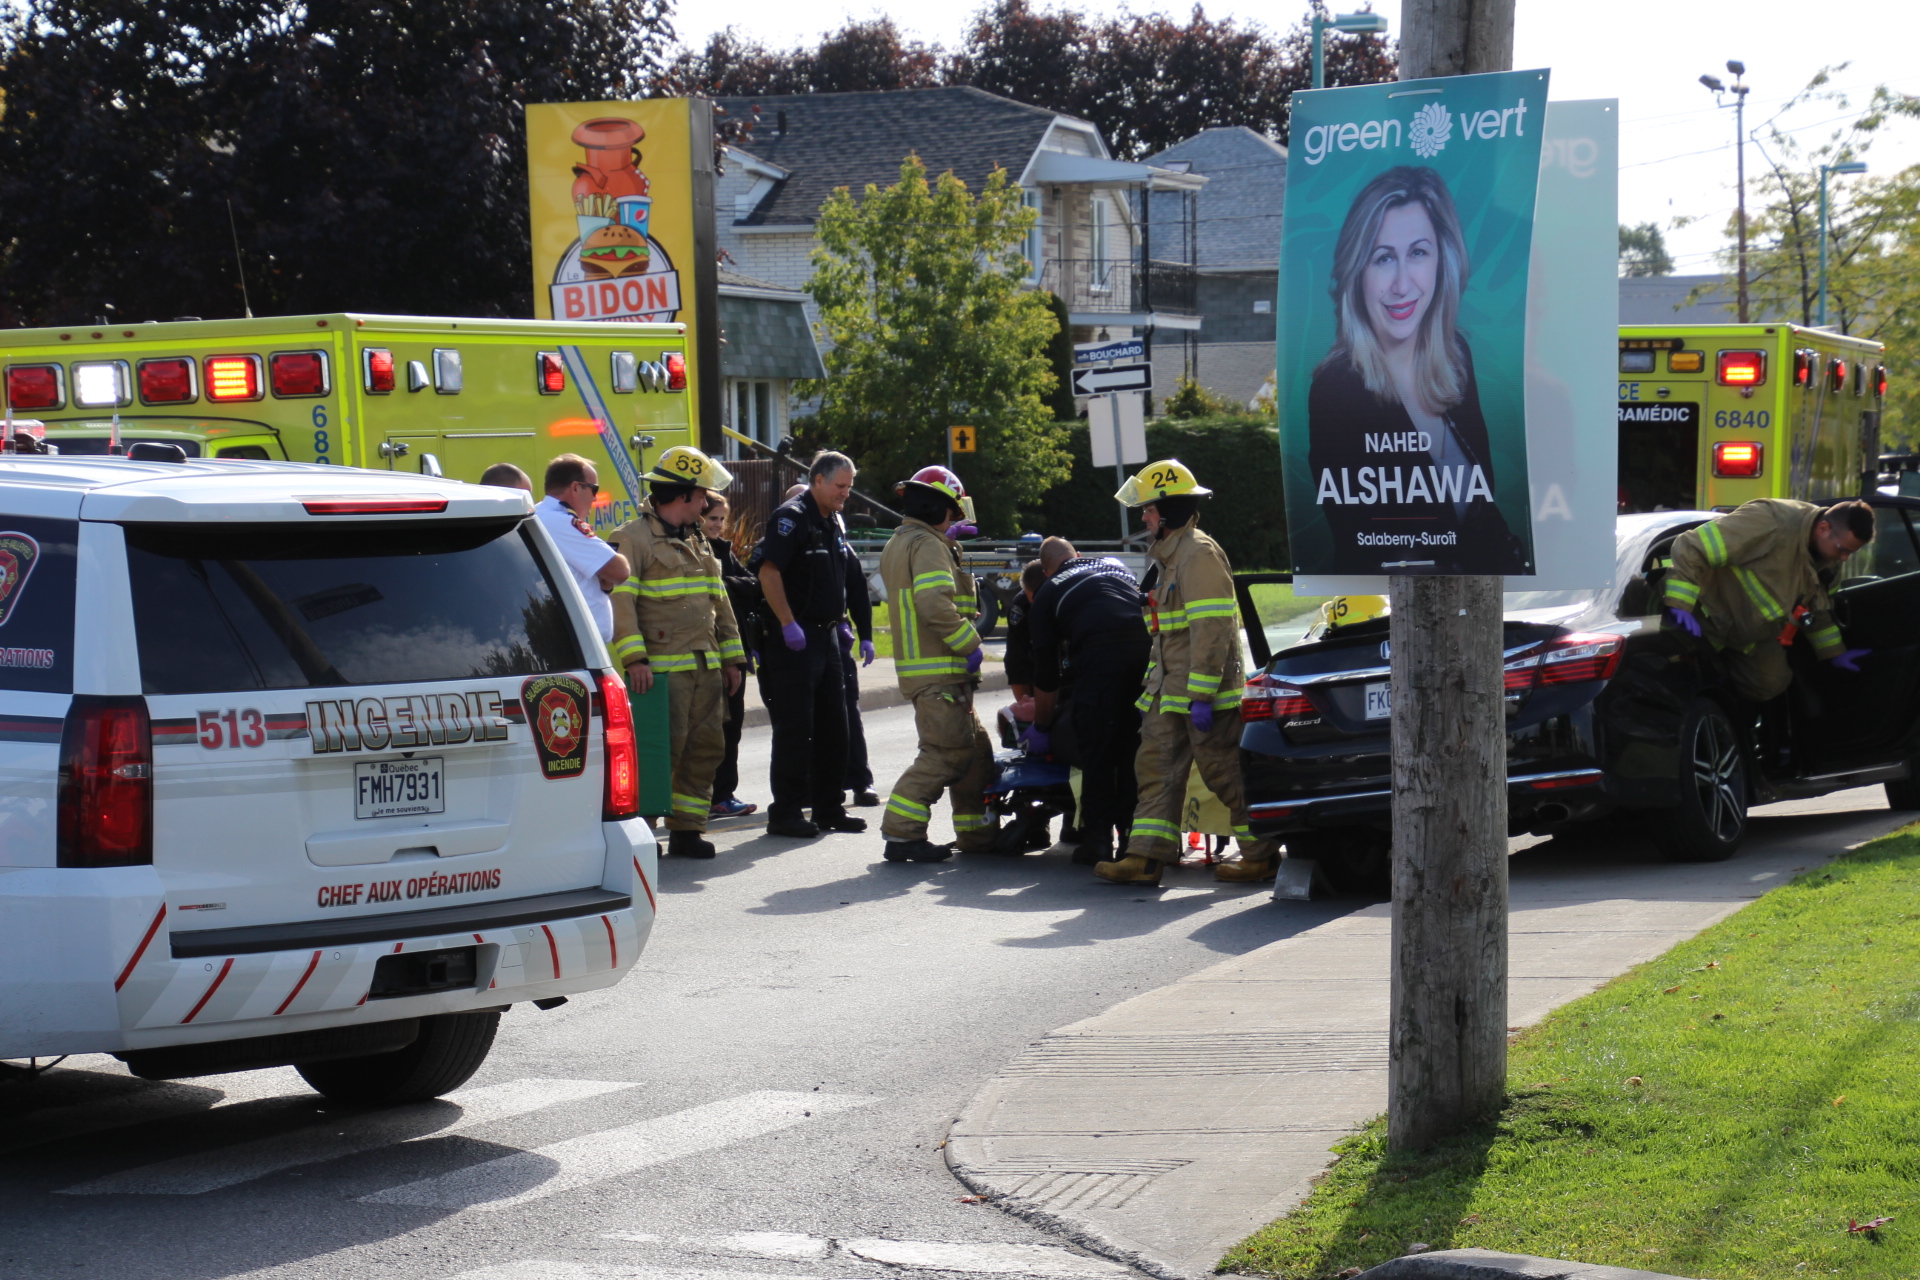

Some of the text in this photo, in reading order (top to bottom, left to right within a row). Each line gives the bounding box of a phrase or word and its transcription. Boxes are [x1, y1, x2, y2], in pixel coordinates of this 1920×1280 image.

[1304, 98, 1527, 165] green vert
[567, 271, 580, 281] Le
[563, 276, 669, 319] BIDON
[1089, 346, 1142, 361] BOUCHARD
[1714, 410, 1770, 428] 6840
[1364, 431, 1432, 453] NAHED
[1151, 468, 1179, 489] 24
[1316, 464, 1494, 505] ALSHAWA
[1331, 598, 1348, 619] 15
[197, 708, 265, 750] 513
[306, 691, 509, 754] INCENDIE
[389, 763, 418, 773] Québec
[548, 757, 581, 771] INCENDIE
[359, 771, 439, 806] FMH7931
[317, 869, 501, 908] CHEF AUX OPÉRATIONS
